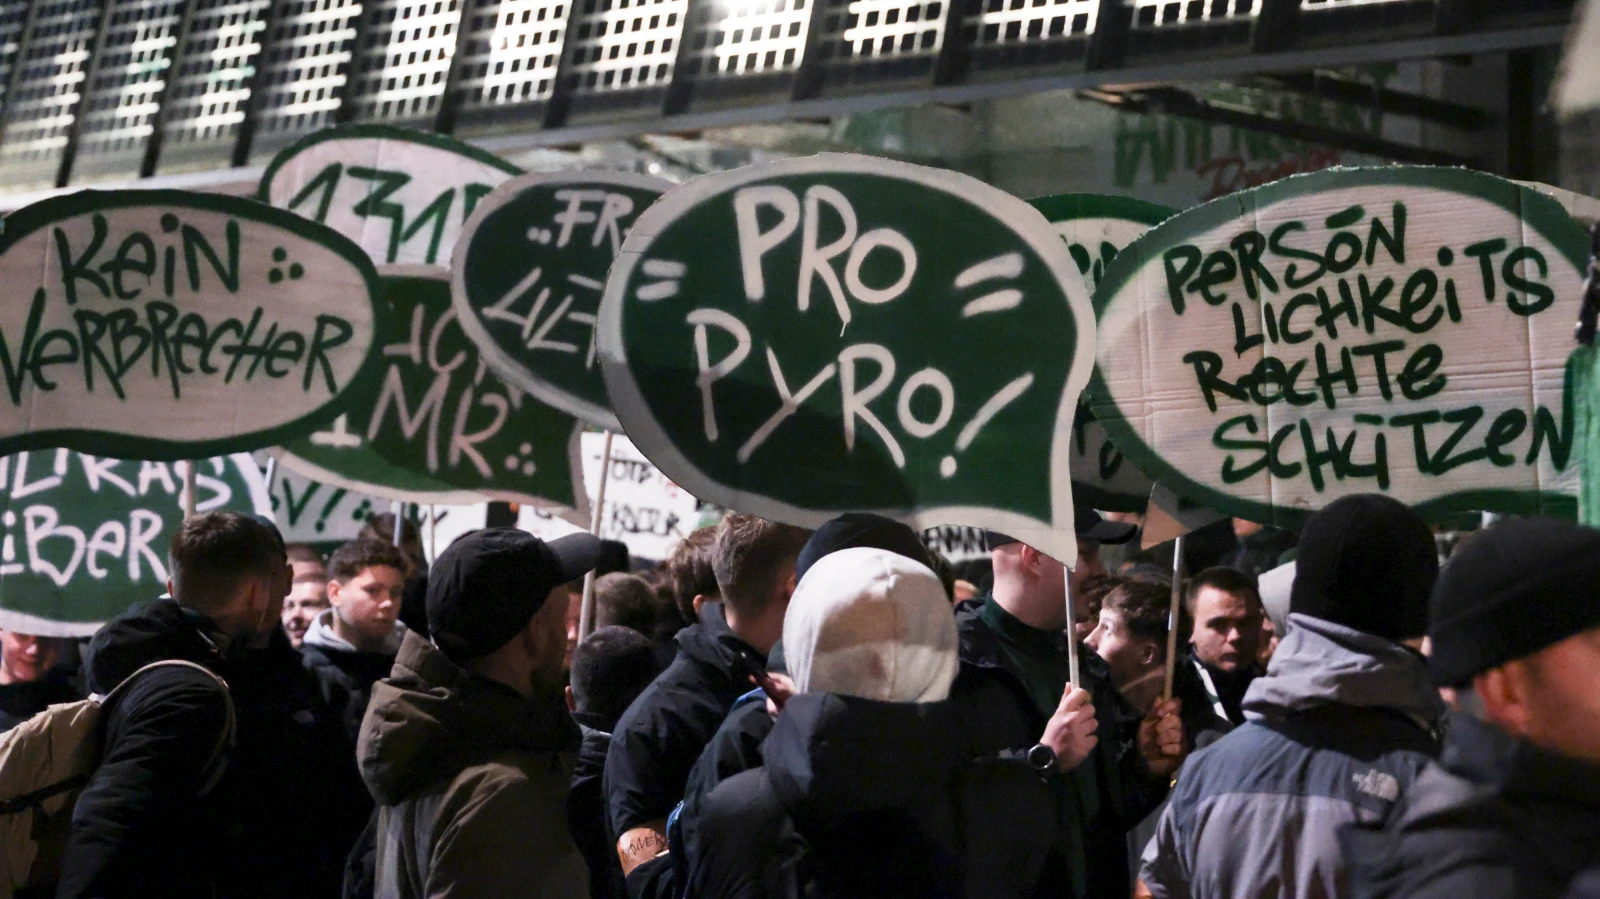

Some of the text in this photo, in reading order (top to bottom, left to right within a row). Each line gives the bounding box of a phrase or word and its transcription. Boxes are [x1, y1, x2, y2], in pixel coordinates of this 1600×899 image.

[554, 189, 635, 260] FR
[734, 184, 917, 326] PRO
[686, 307, 1035, 478] PYRO!
